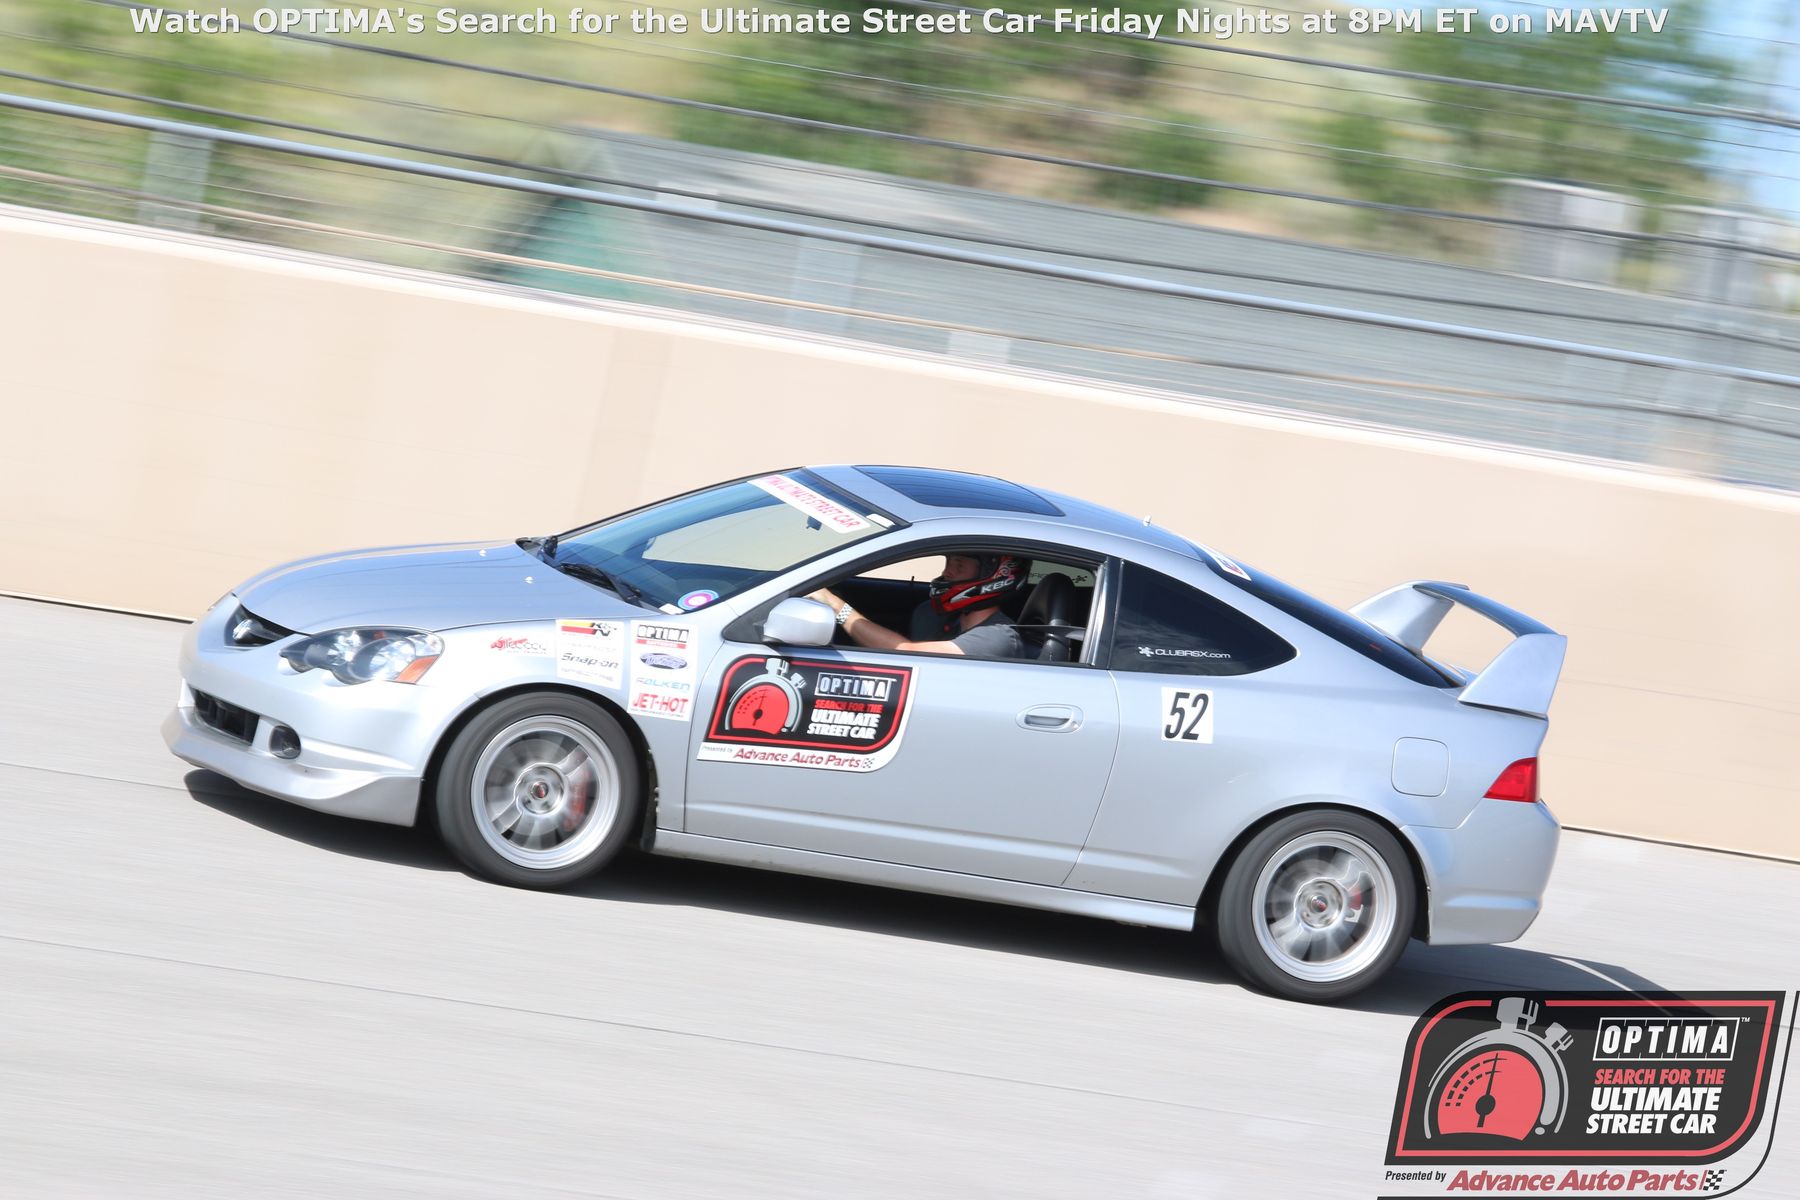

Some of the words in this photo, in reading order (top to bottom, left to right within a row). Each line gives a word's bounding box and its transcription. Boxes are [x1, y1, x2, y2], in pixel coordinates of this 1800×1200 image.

[832, 513, 862, 528] CAR
[981, 578, 1014, 594] KBC
[637, 624, 689, 644] OPTIMA
[561, 652, 619, 669] Snap-on
[1155, 648, 1231, 659] CLUBRSX.com
[820, 676, 886, 698] OPTIMA
[632, 692, 689, 713] JET-HOT
[814, 699, 847, 711] SEARCH
[848, 702, 866, 713] FOR
[866, 703, 883, 714] THE
[811, 708, 881, 728] ULTIMATE
[1164, 691, 1209, 740] 52
[807, 722, 851, 737] STREET
[849, 726, 876, 739] CAR
[733, 748, 788, 762] Advance
[790, 752, 823, 765] Auto
[825, 754, 861, 768] Parts
